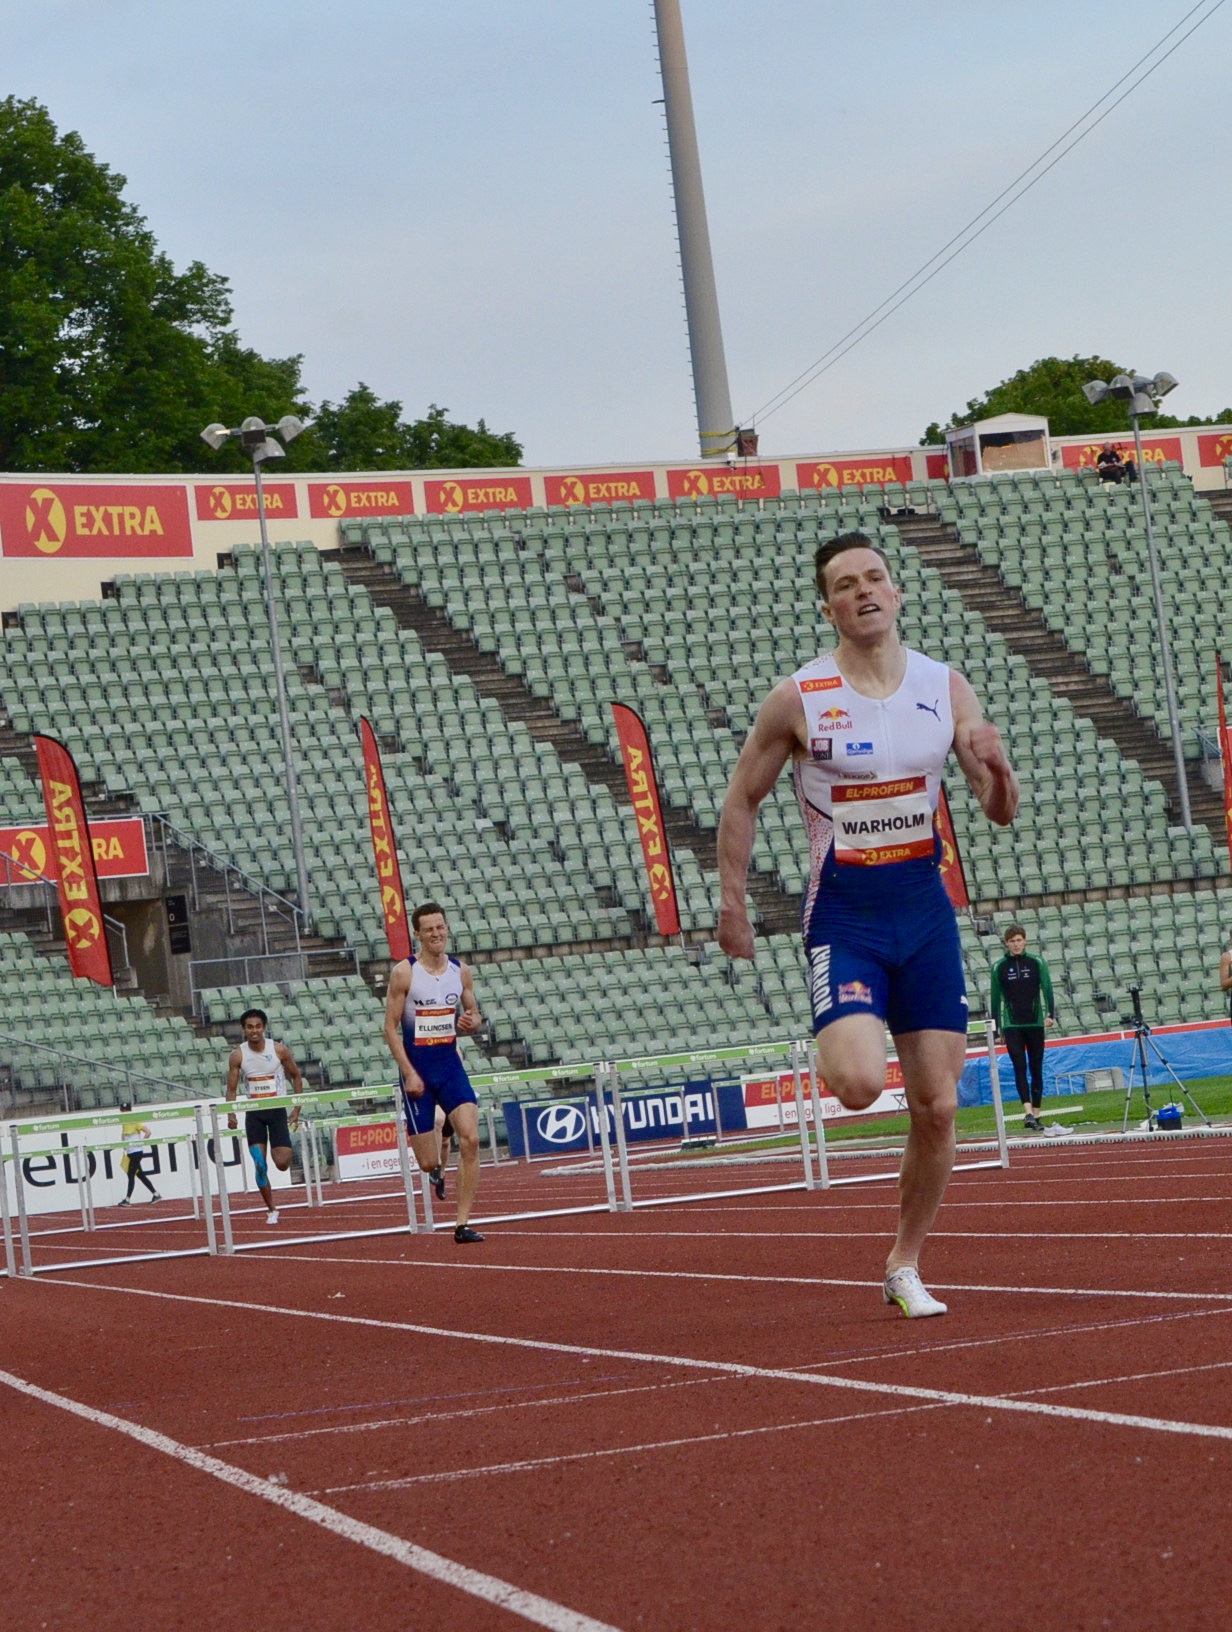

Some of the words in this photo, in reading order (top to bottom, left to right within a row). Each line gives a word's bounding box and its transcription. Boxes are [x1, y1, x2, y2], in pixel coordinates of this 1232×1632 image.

[1113, 447, 1166, 463] XTRA
[843, 466, 897, 484] EXTRA
[589, 481, 641, 498] EXTRA
[712, 475, 765, 492] EXTRA
[235, 493, 283, 509] EXTRA
[350, 490, 399, 507] EXTRA
[467, 487, 517, 503] EXTRA
[74, 505, 164, 535] EXTRA
[818, 722, 835, 732] Red
[836, 720, 853, 730] Bull
[814, 740, 829, 751] JOB
[845, 782, 914, 798] EL-PROFFEN
[841, 813, 925, 835] WARHOLM
[880, 848, 911, 859] EXTRA
[810, 944, 833, 1019] NORWAY
[157, 1110, 179, 1118] fortum
[825, 1103, 841, 1116] liga
[98, 1117, 120, 1126] fortum
